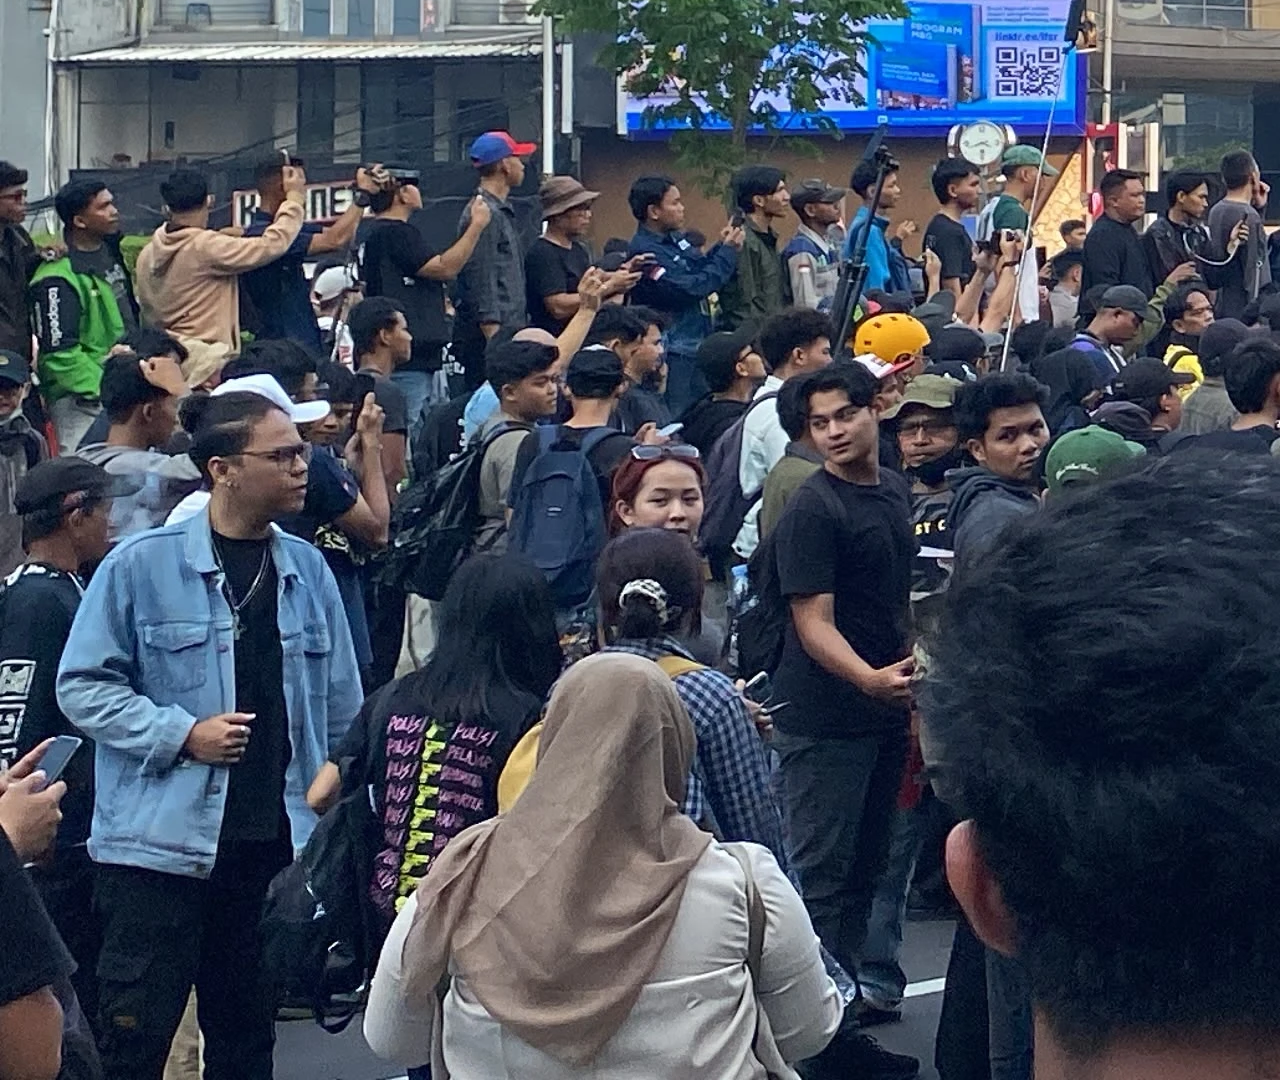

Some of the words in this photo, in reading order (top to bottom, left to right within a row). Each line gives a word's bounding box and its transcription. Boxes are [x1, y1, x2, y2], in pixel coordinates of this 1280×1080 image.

[911, 22, 963, 36] PROGRAM
[47, 286, 63, 347] tokopedia
[451, 722, 499, 748] POLISI
